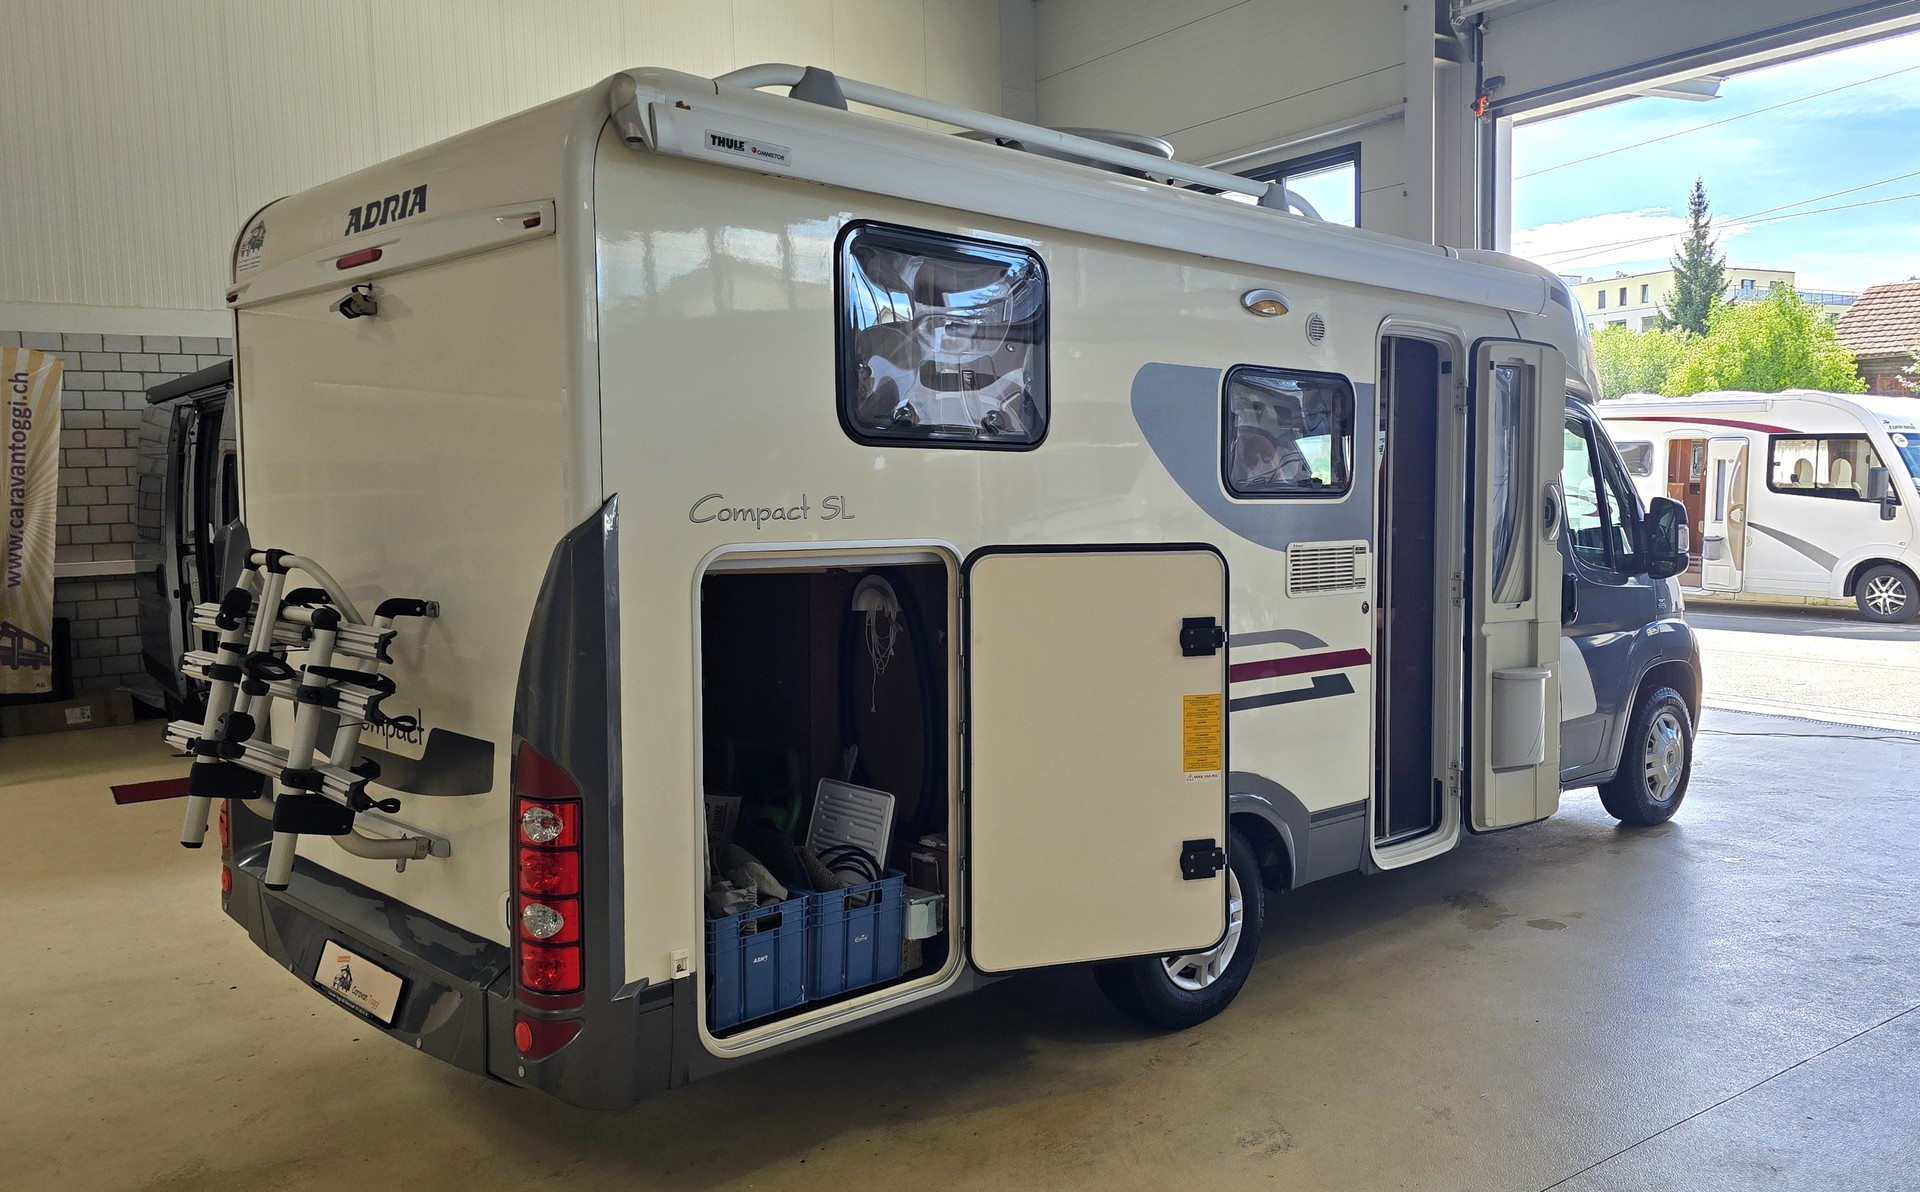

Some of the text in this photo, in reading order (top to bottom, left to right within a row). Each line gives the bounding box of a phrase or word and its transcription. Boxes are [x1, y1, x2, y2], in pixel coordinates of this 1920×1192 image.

[710, 134, 746, 152] THULE
[756, 149, 785, 161] OMNISTOR
[344, 183, 428, 237] ADRIA
[7, 371, 32, 589] www.caravantoggi.ch
[688, 493, 856, 530] Compact SL
